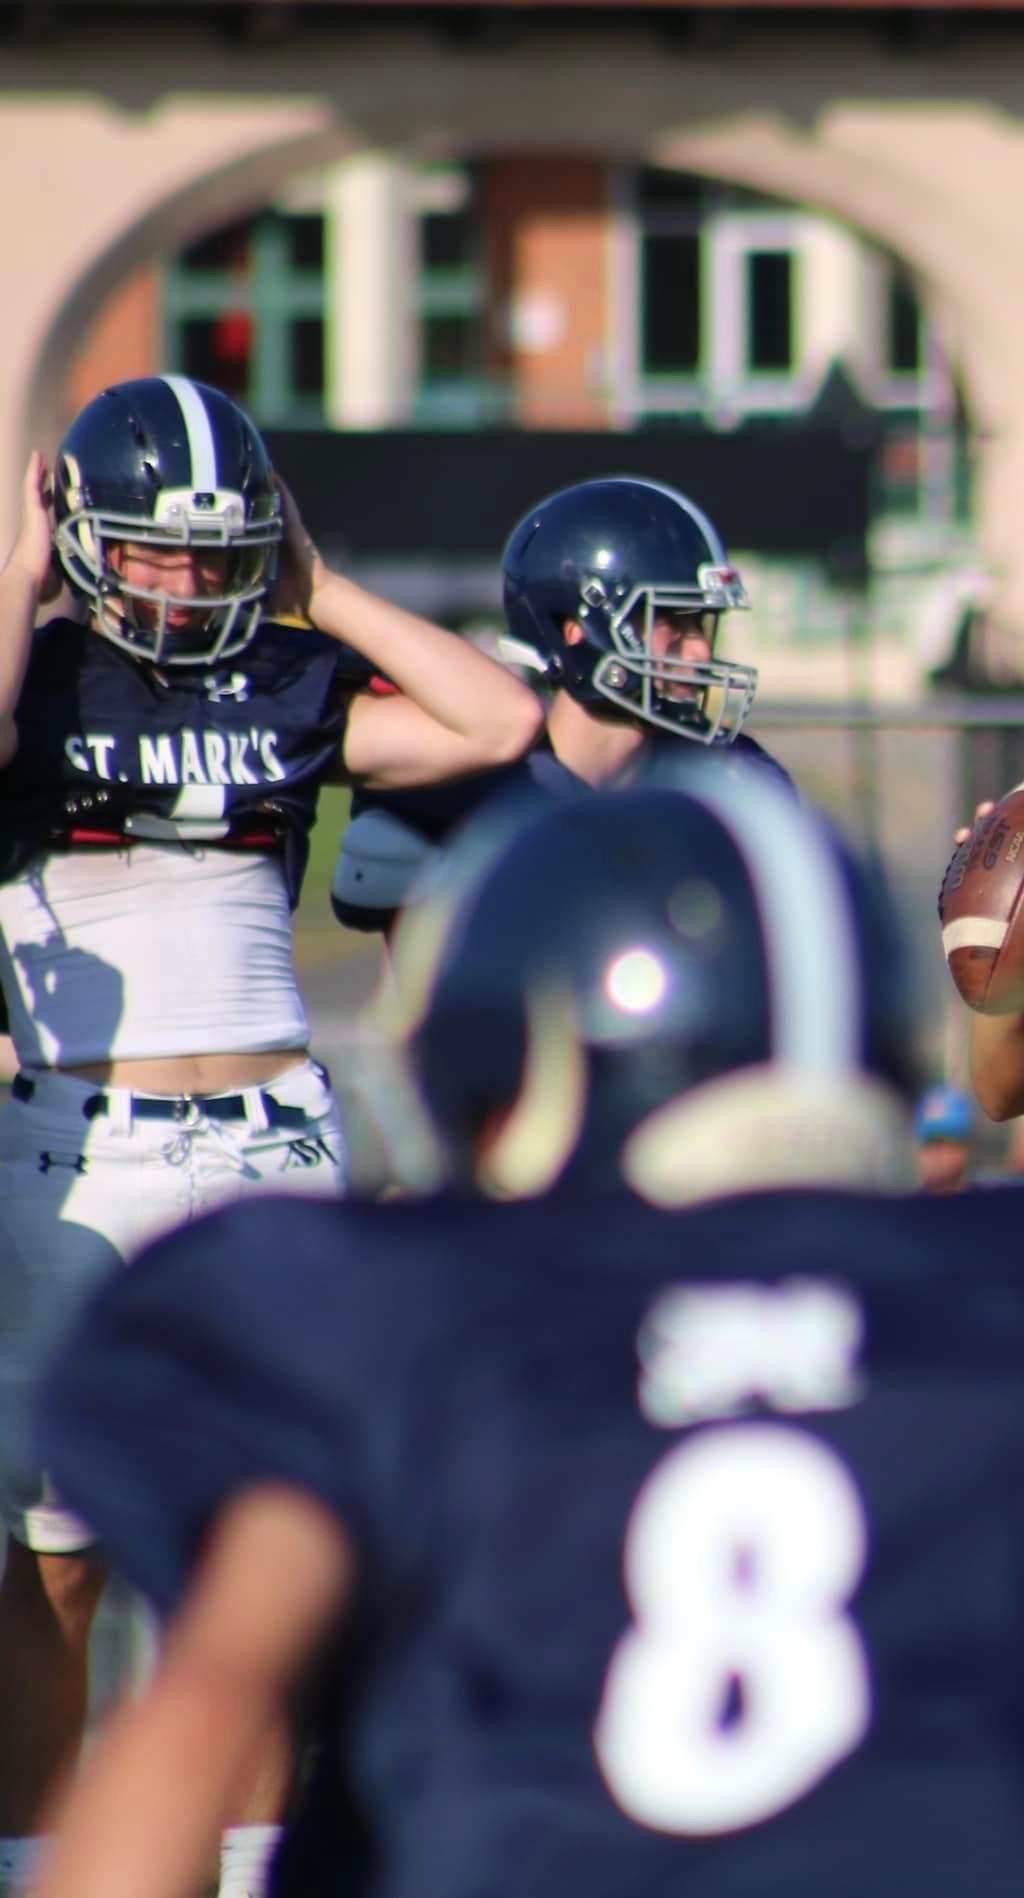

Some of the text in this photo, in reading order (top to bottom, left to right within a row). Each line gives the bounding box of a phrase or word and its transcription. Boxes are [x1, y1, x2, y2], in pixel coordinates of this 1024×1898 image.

[64, 728, 286, 785] ST. MARK'S
[1005, 831, 1024, 863] NCAA
[594, 1422, 871, 1836] 8
